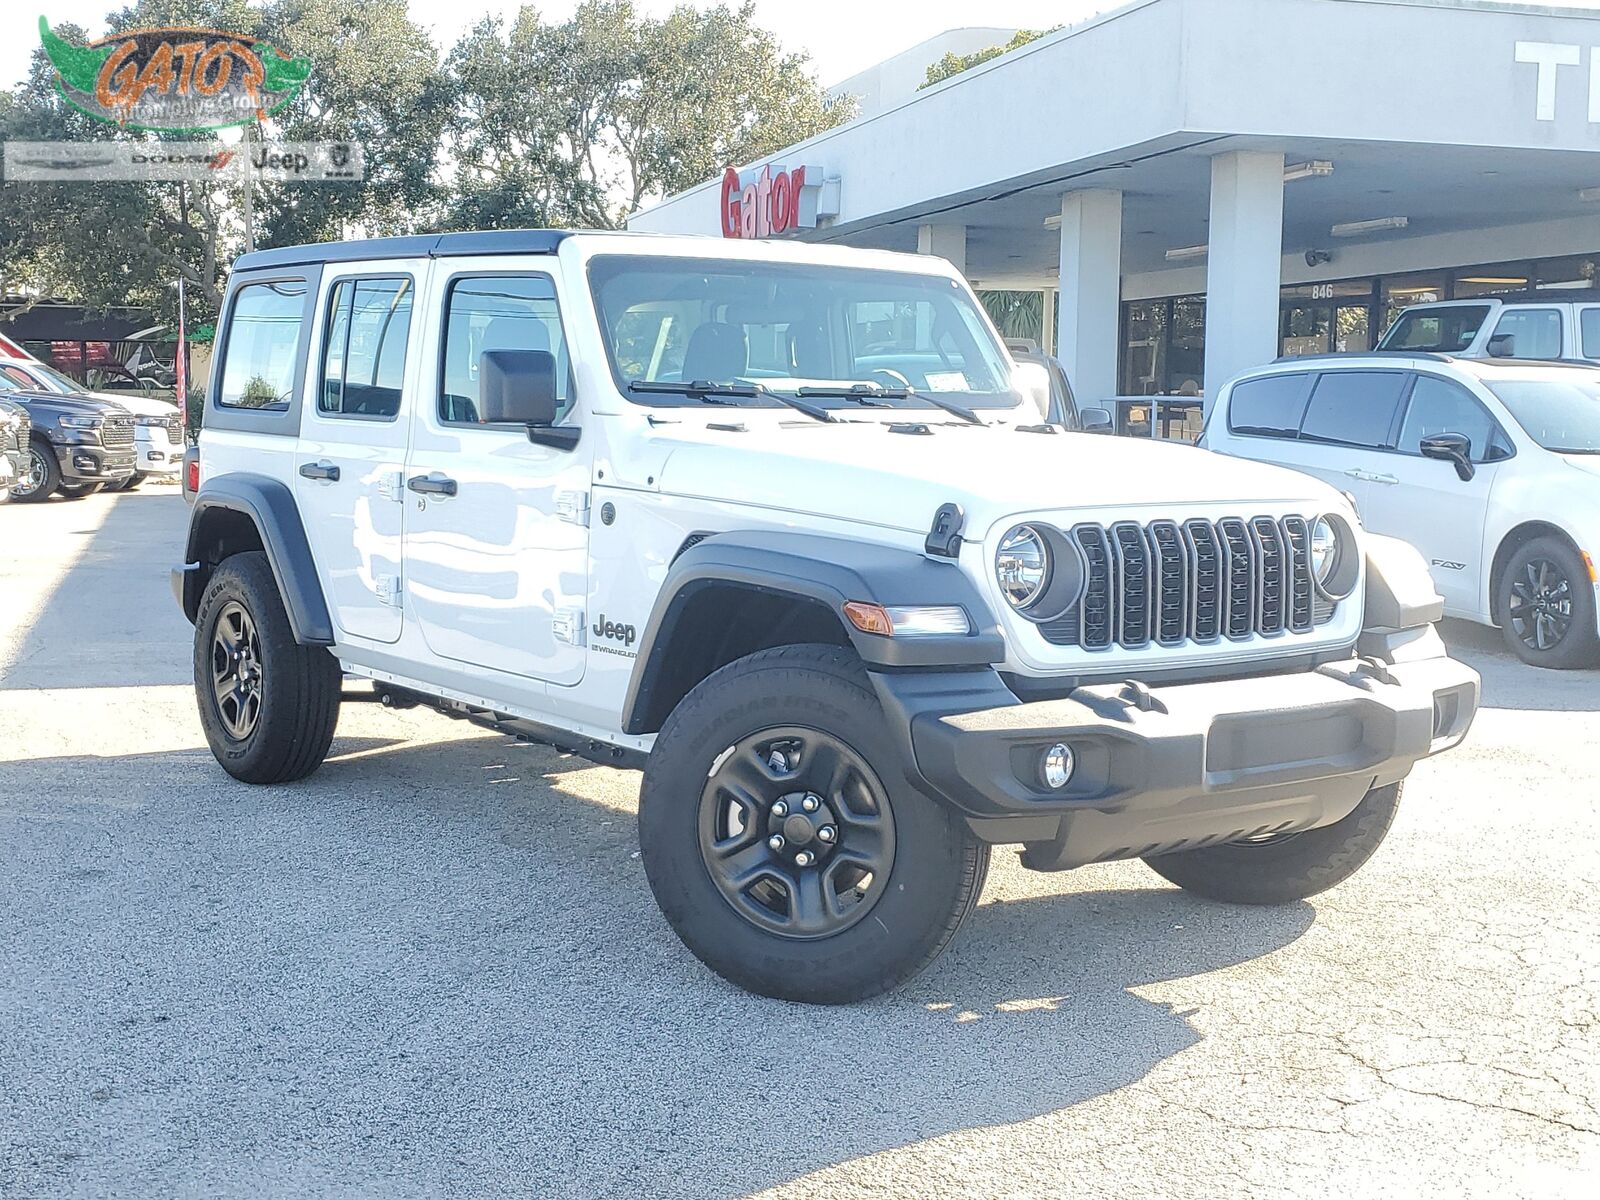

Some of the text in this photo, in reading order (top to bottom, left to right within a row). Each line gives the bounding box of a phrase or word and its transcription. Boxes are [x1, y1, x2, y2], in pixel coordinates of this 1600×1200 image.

[721, 164, 806, 239] Gator
[1312, 283, 1333, 300] 846
[593, 613, 636, 647] Jeep
